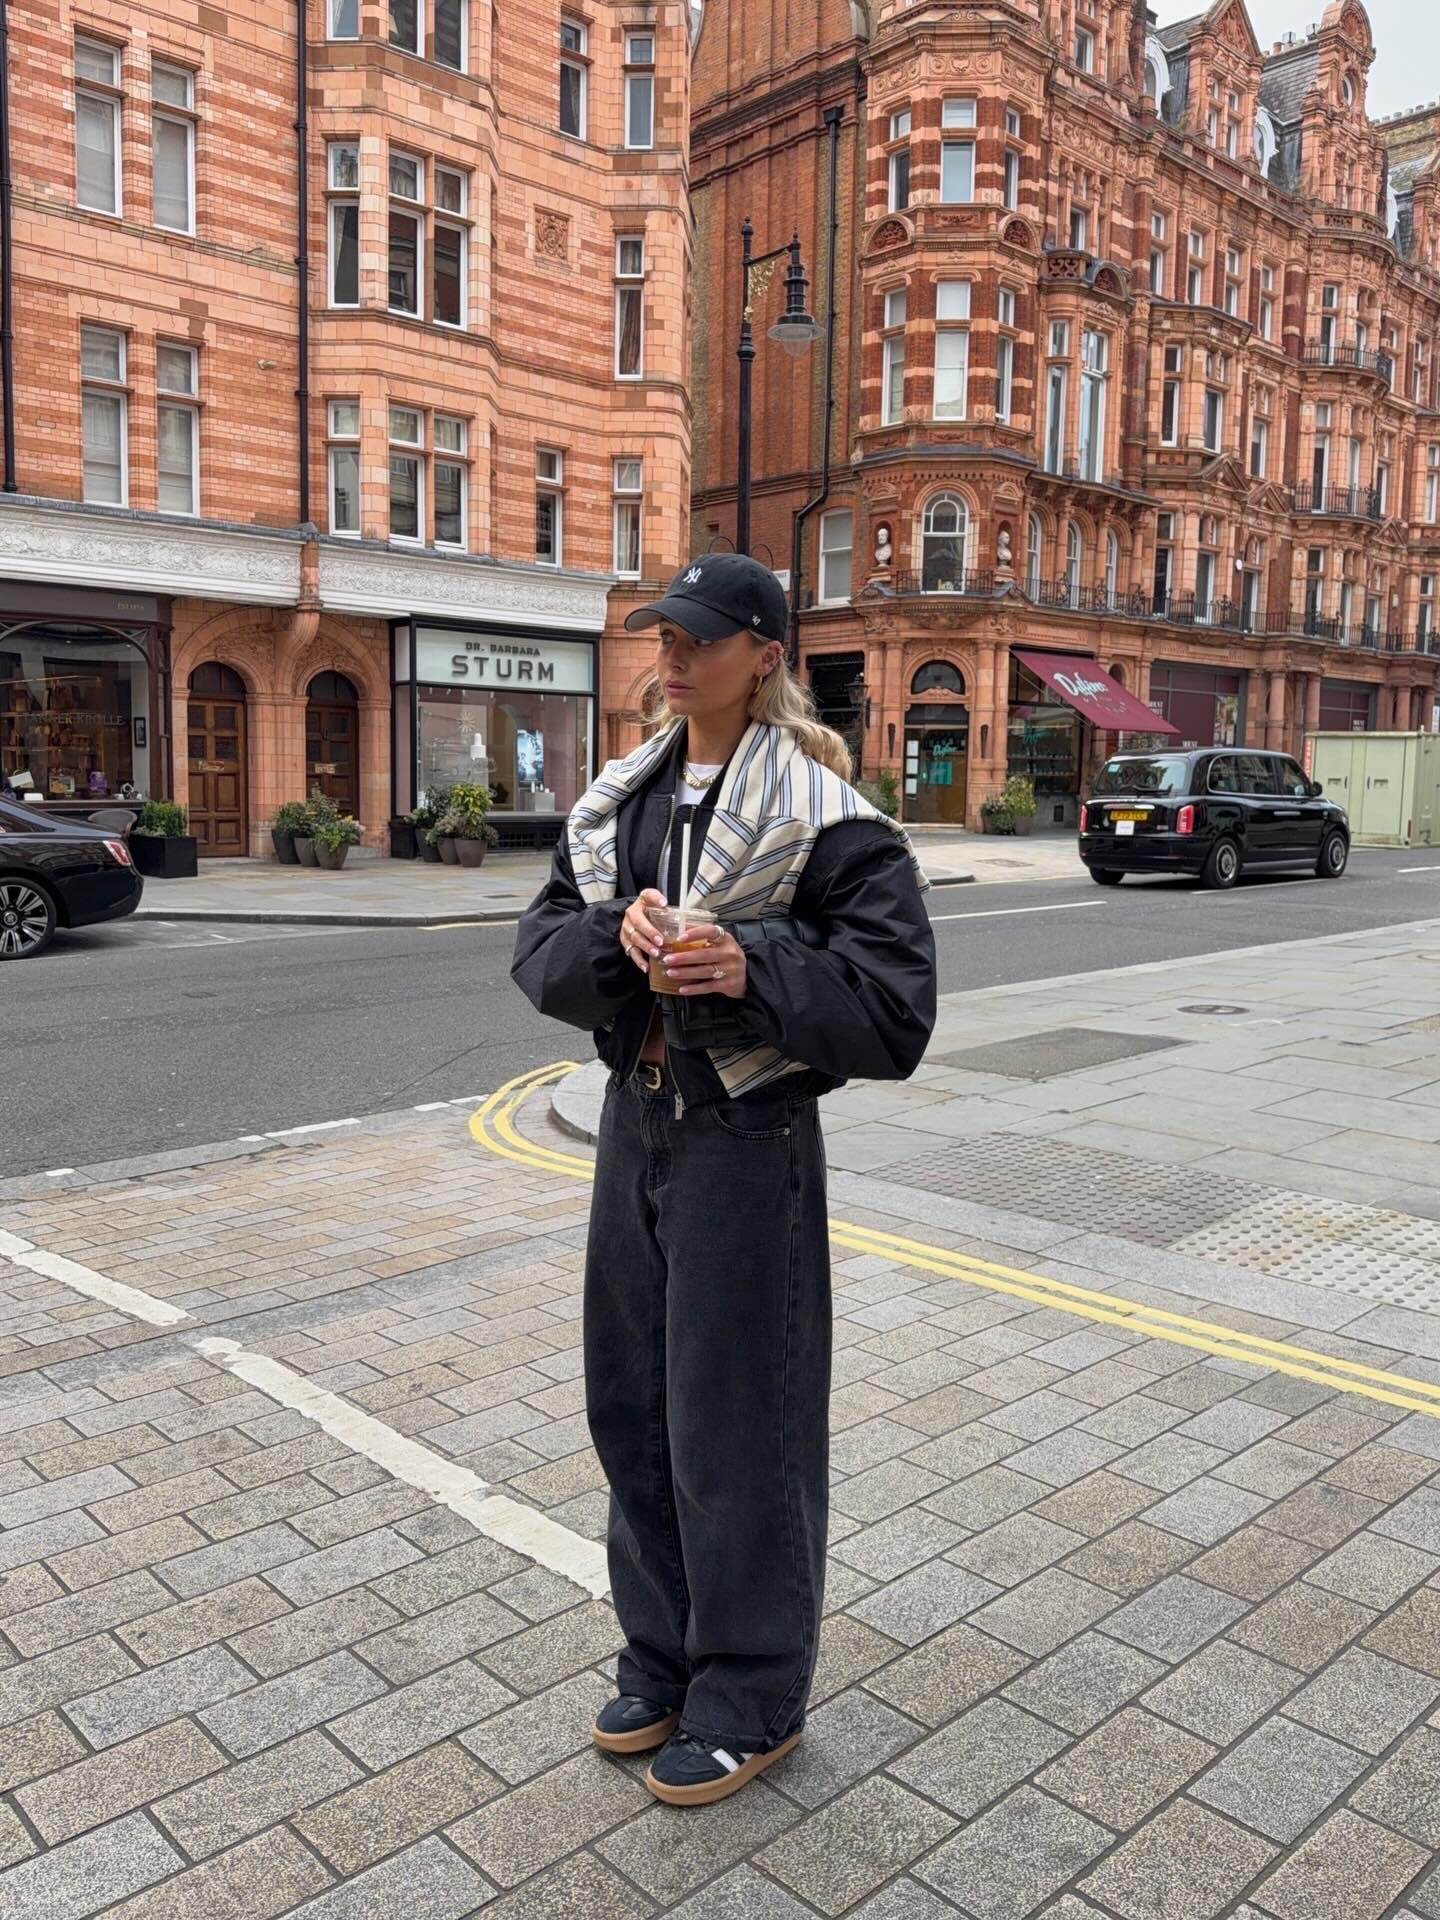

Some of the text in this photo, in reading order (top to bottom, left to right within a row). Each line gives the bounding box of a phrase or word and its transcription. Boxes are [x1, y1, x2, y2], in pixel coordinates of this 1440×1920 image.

[465, 641, 541, 656] DR. BARBARA
[451, 654, 554, 682] STURM
